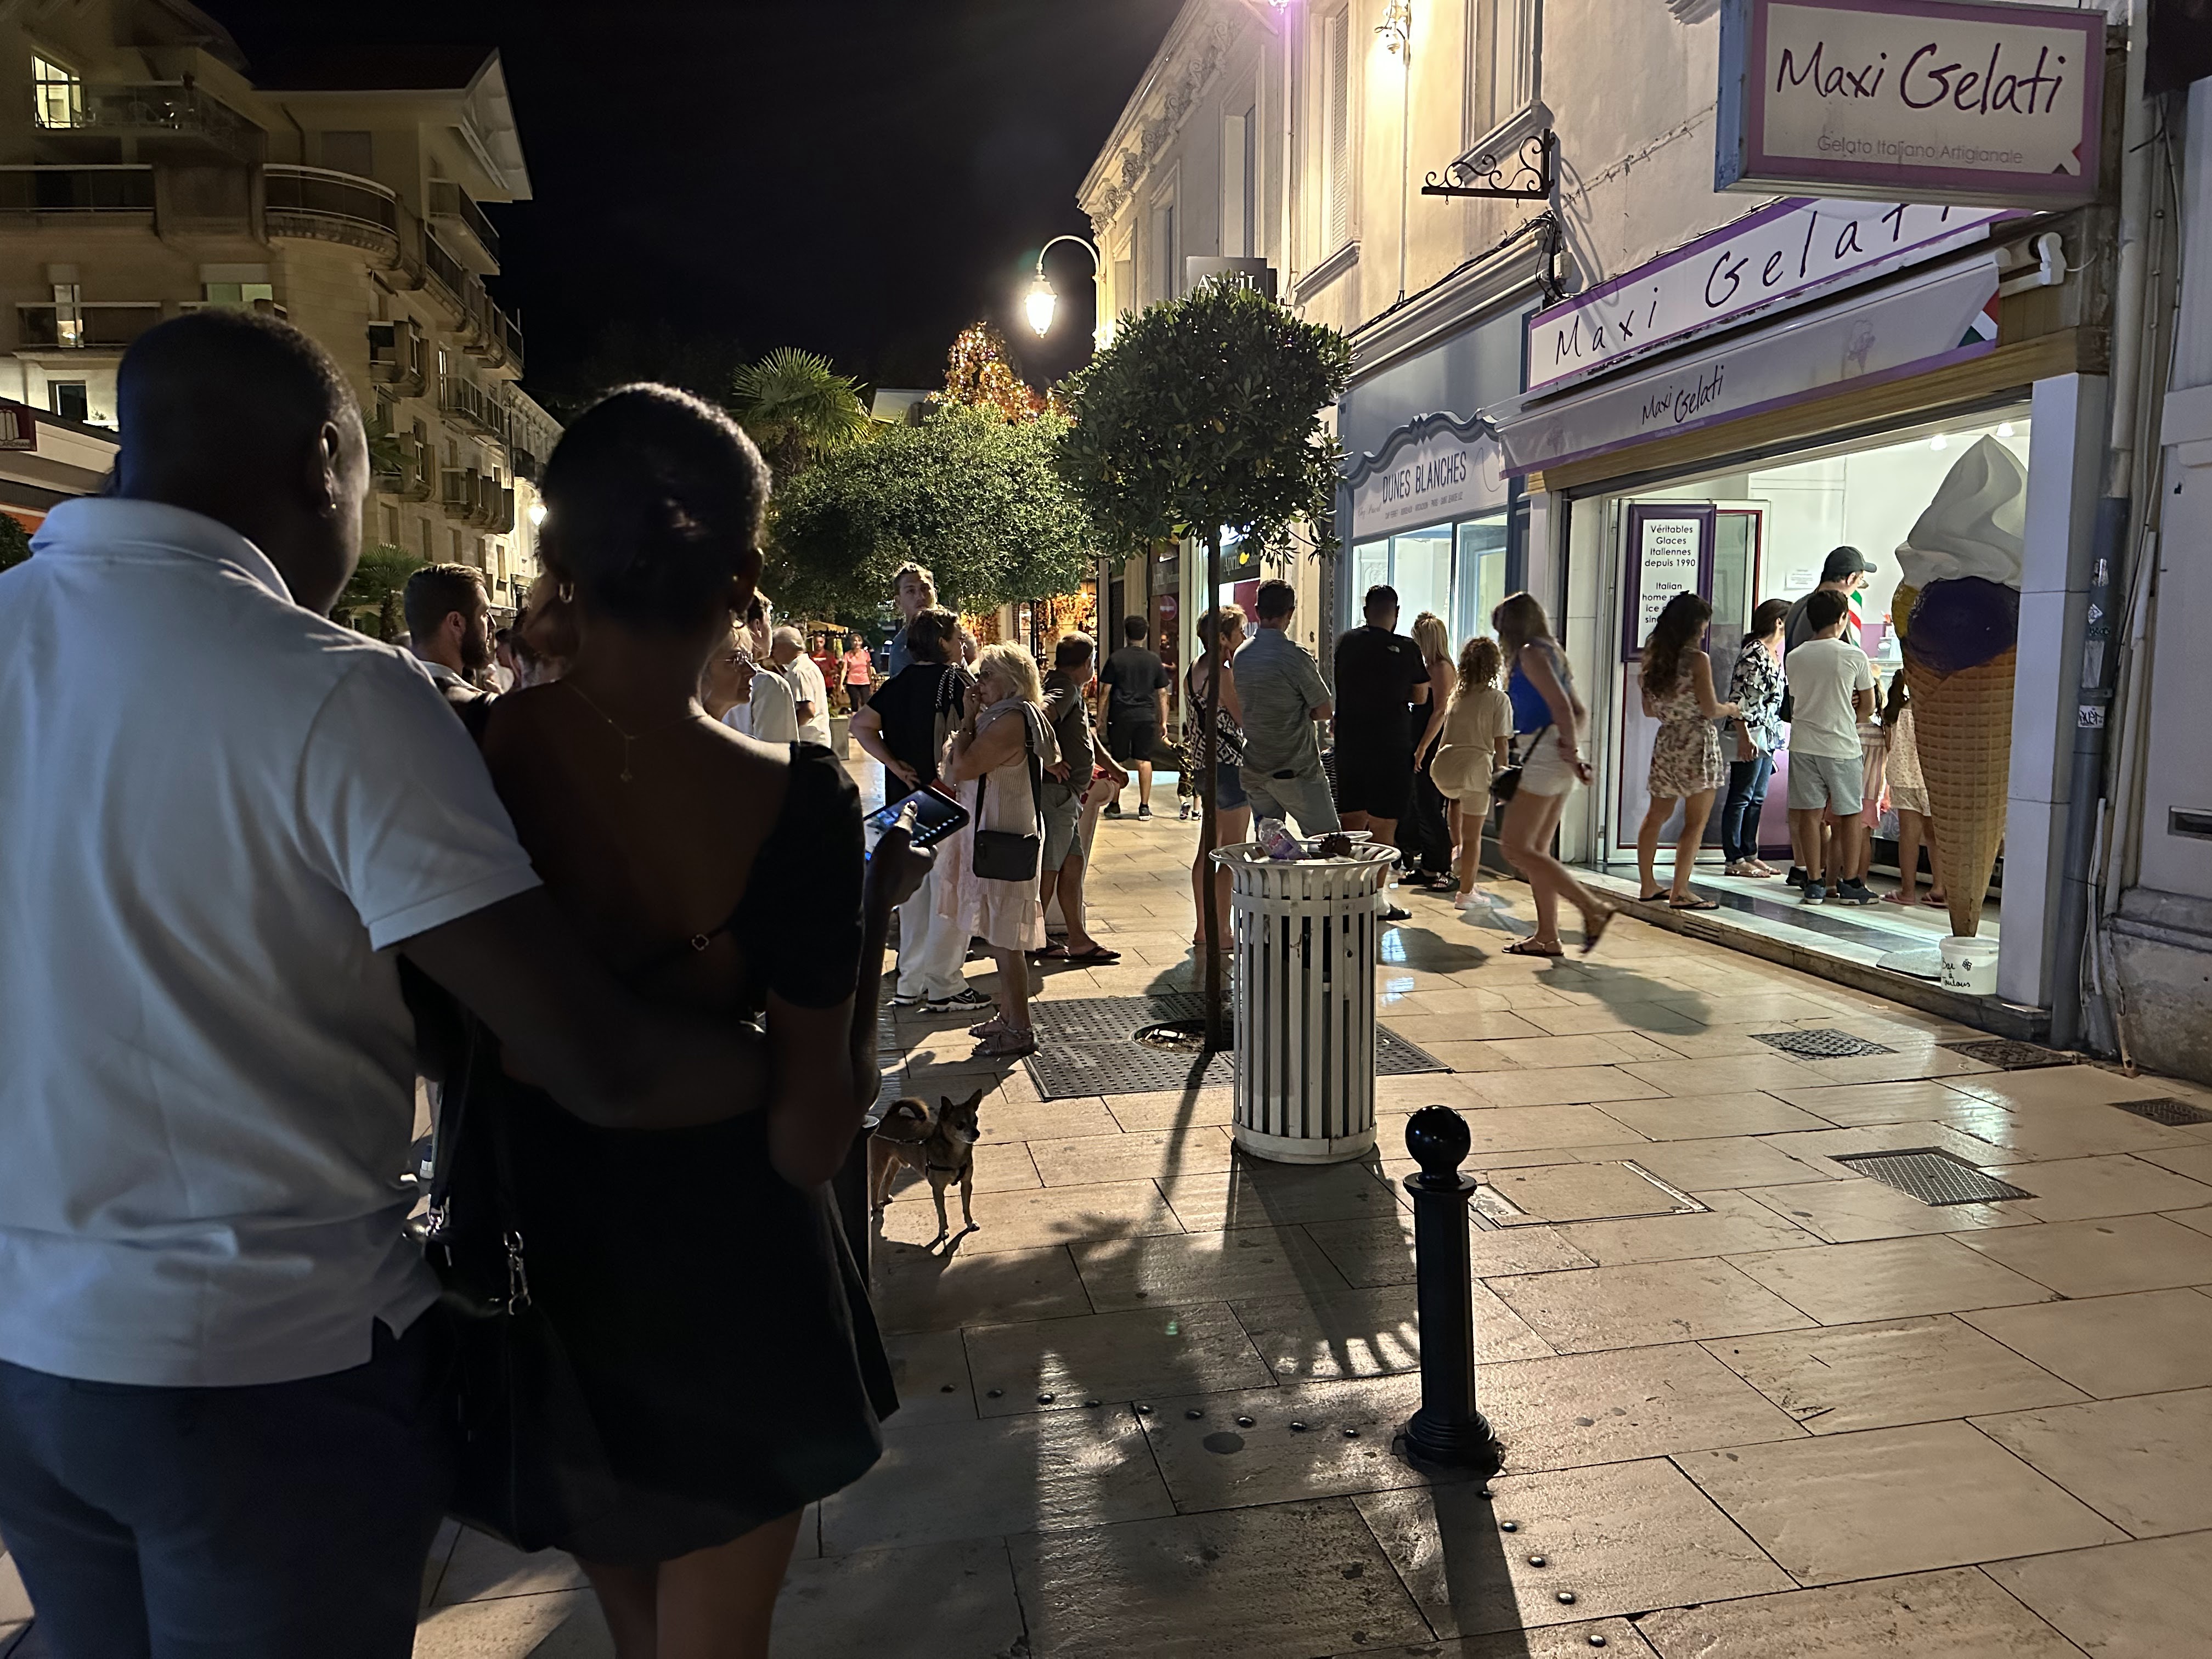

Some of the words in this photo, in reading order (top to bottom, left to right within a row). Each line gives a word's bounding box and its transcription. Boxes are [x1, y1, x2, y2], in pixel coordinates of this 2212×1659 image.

[1776, 41, 1887, 99] Maxi
[1900, 42, 2067, 115] Gelati
[1817, 136, 1872, 155] Gelato
[1877, 139, 1936, 159] Italiano
[1940, 145, 2024, 165] Artigianale
[1556, 287, 1658, 366] Maxi
[1642, 385, 1673, 425] Maxi
[1674, 364, 1724, 424] Gelati
[1383, 470, 1411, 504] DUNES
[1415, 451, 1467, 494] BLANCHES
[1650, 524, 1693, 533] Véritables
[1645, 558, 1673, 568] depuis
[1650, 548, 1691, 556] Italiennes
[1645, 615, 1657, 623] sin
